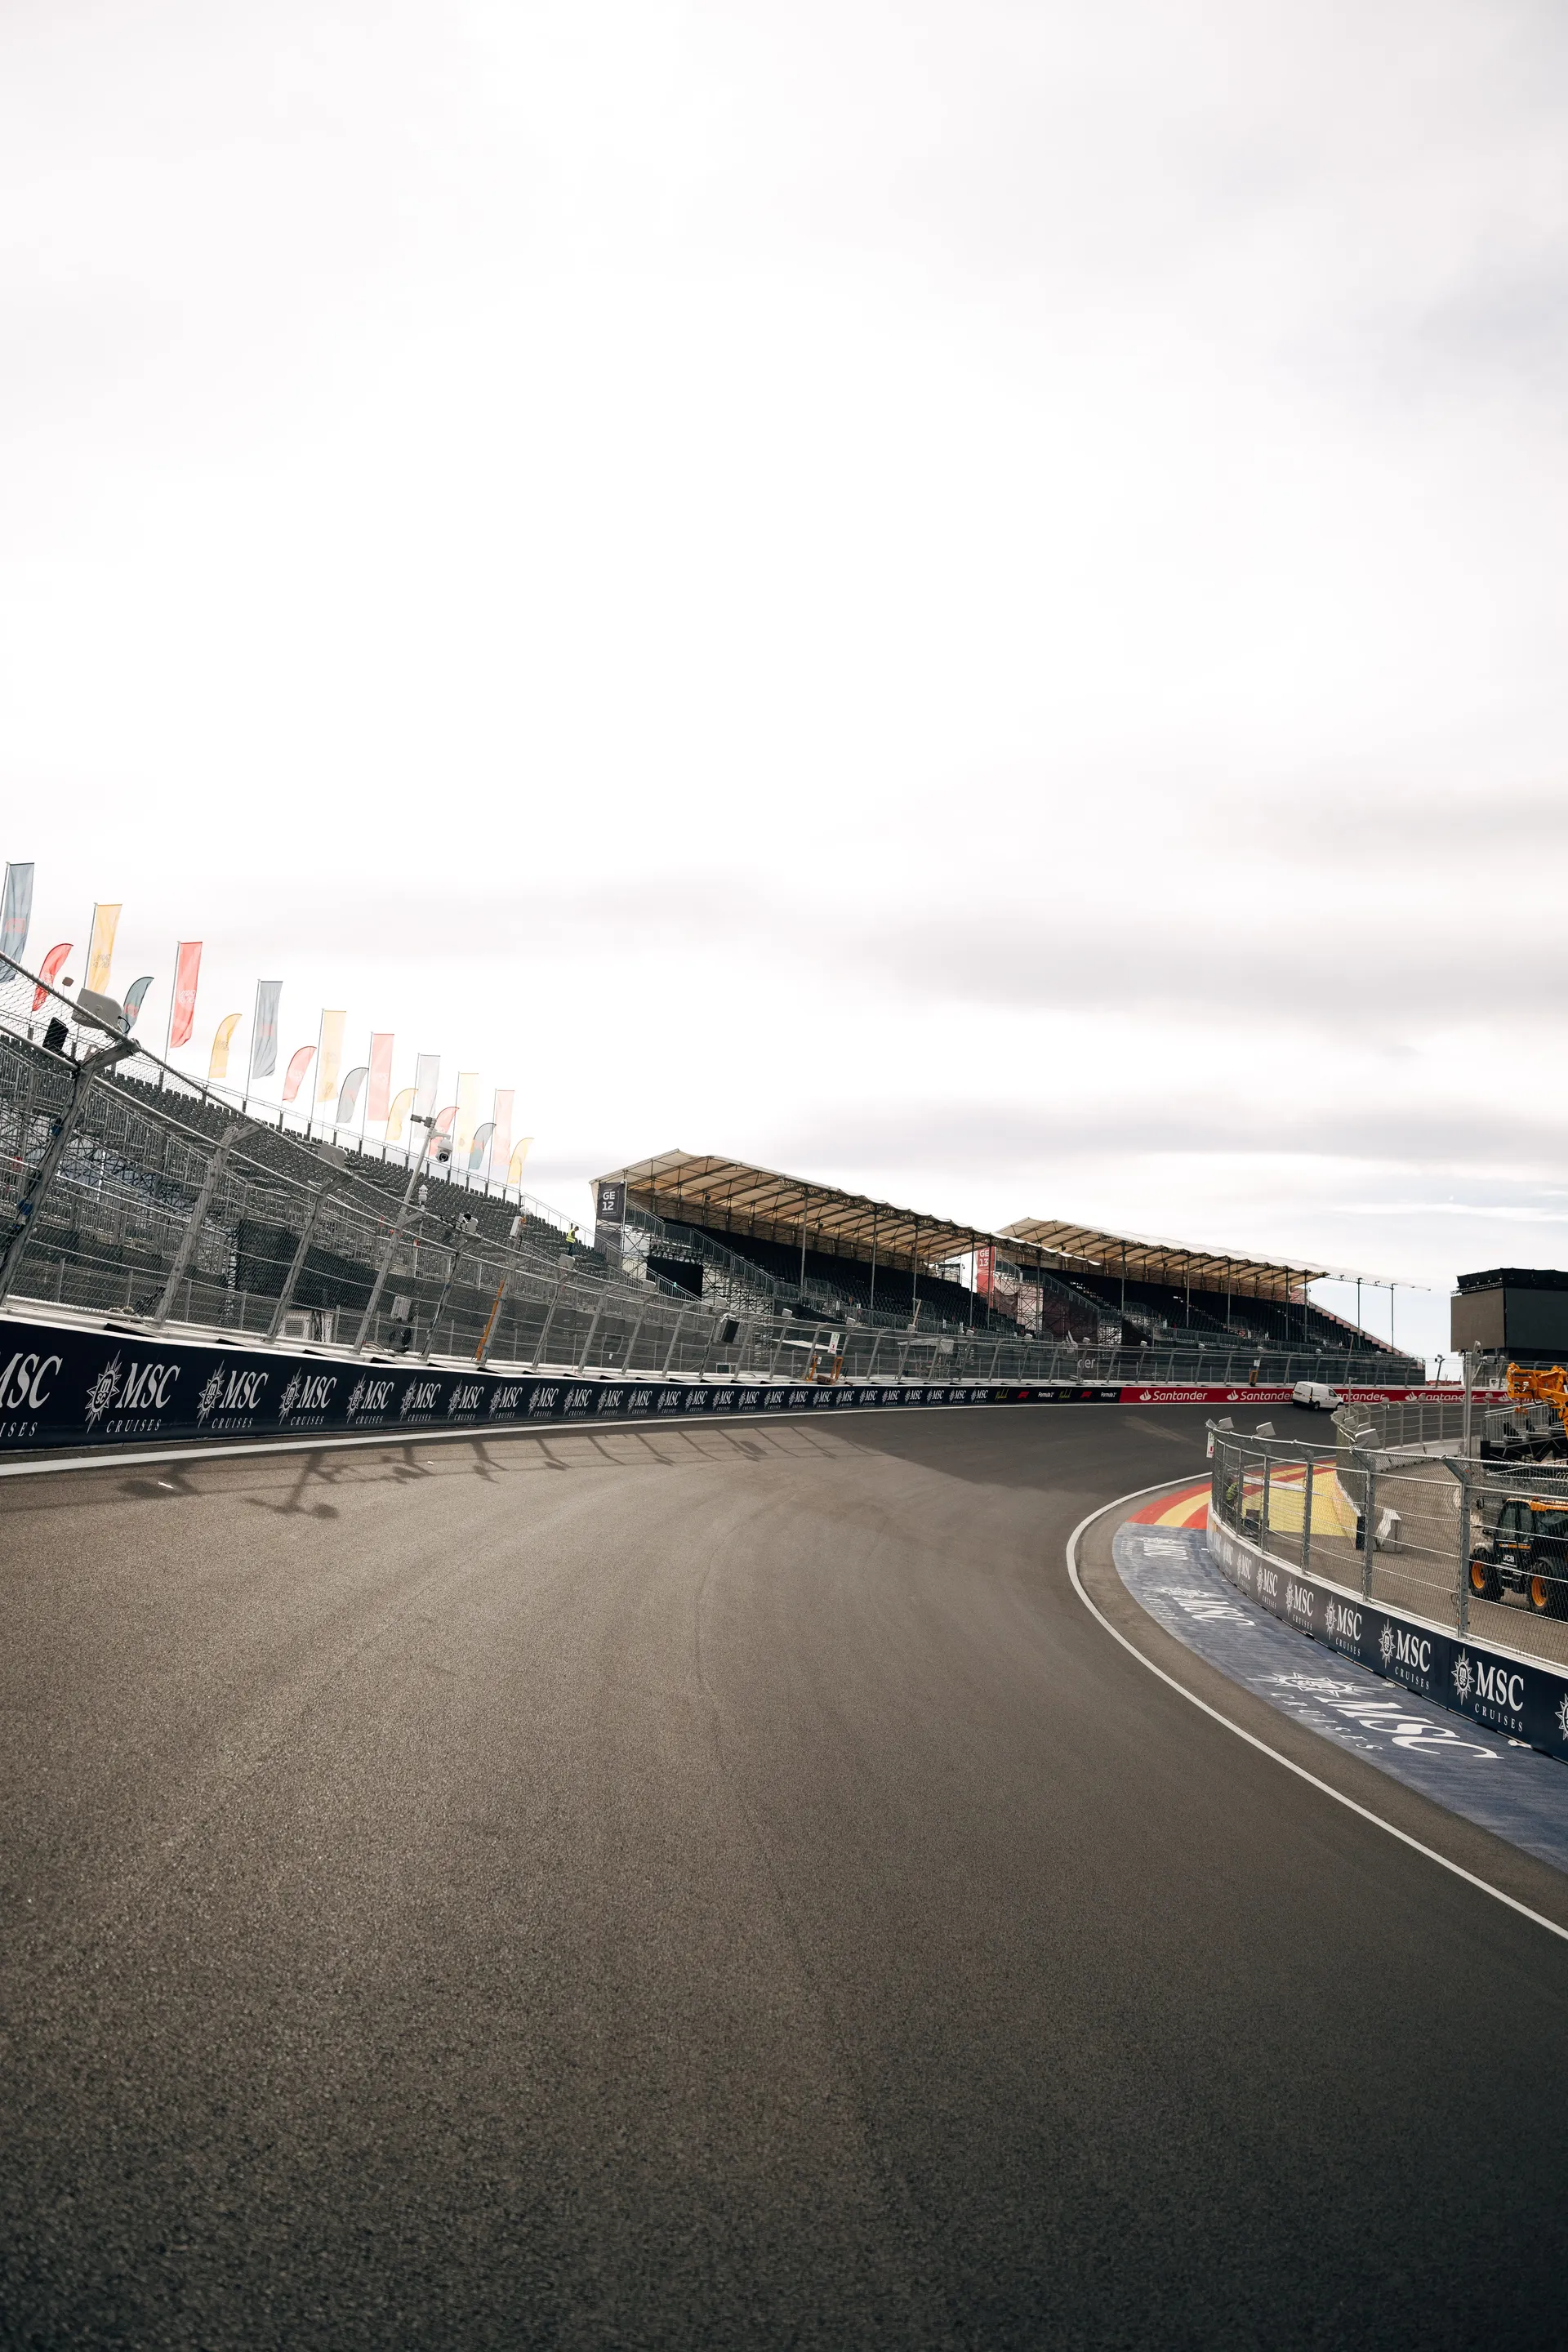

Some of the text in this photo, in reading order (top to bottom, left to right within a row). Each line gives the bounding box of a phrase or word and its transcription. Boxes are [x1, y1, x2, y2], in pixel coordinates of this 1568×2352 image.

[603, 1192, 616, 1200] GE
[602, 1201, 614, 1211] 12
[980, 1258, 989, 1267] 13
[115, 1363, 180, 1409] MSC
[218, 1370, 269, 1409] MSC
[296, 1376, 337, 1409] MSC
[361, 1380, 394, 1410] MSC
[412, 1383, 442, 1409] MSC
[458, 1386, 484, 1409] MSC
[499, 1387, 523, 1408] MSC
[535, 1388, 559, 1407] MSC
[572, 1388, 592, 1407] MSC
[606, 1390, 624, 1407] MSC
[635, 1390, 653, 1406] MSC
[664, 1391, 681, 1406] MSC
[692, 1391, 708, 1405] MSC
[719, 1391, 734, 1404] MSC
[745, 1391, 760, 1404] MSC
[769, 1391, 785, 1404] MSC
[795, 1391, 808, 1403] MSC
[817, 1391, 832, 1403] MSC
[842, 1391, 855, 1402] MSC
[1152, 1391, 1207, 1401] Santander
[1338, 1392, 1384, 1401] antander
[106, 1419, 162, 1433] CRUISES
[212, 1418, 253, 1429] CRUISES
[290, 1415, 324, 1426] CRUISES
[355, 1416, 383, 1424] CRUISES
[1503, 1554, 1515, 1563] JCB
[1263, 1567, 1278, 1597] MSC
[1293, 1584, 1314, 1617] MSC
[1293, 1614, 1313, 1631] CRUISES
[1337, 1605, 1362, 1642] MSC
[1335, 1637, 1361, 1657] CRUISES
[1396, 1629, 1431, 1673] MSC
[1395, 1665, 1429, 1690] CRUISES
[1475, 1661, 1524, 1712] MSC
[1271, 1692, 1383, 1750] CRUISES
[1475, 1703, 1523, 1732] CRUISES
[1313, 1695, 1505, 1760] MSC
